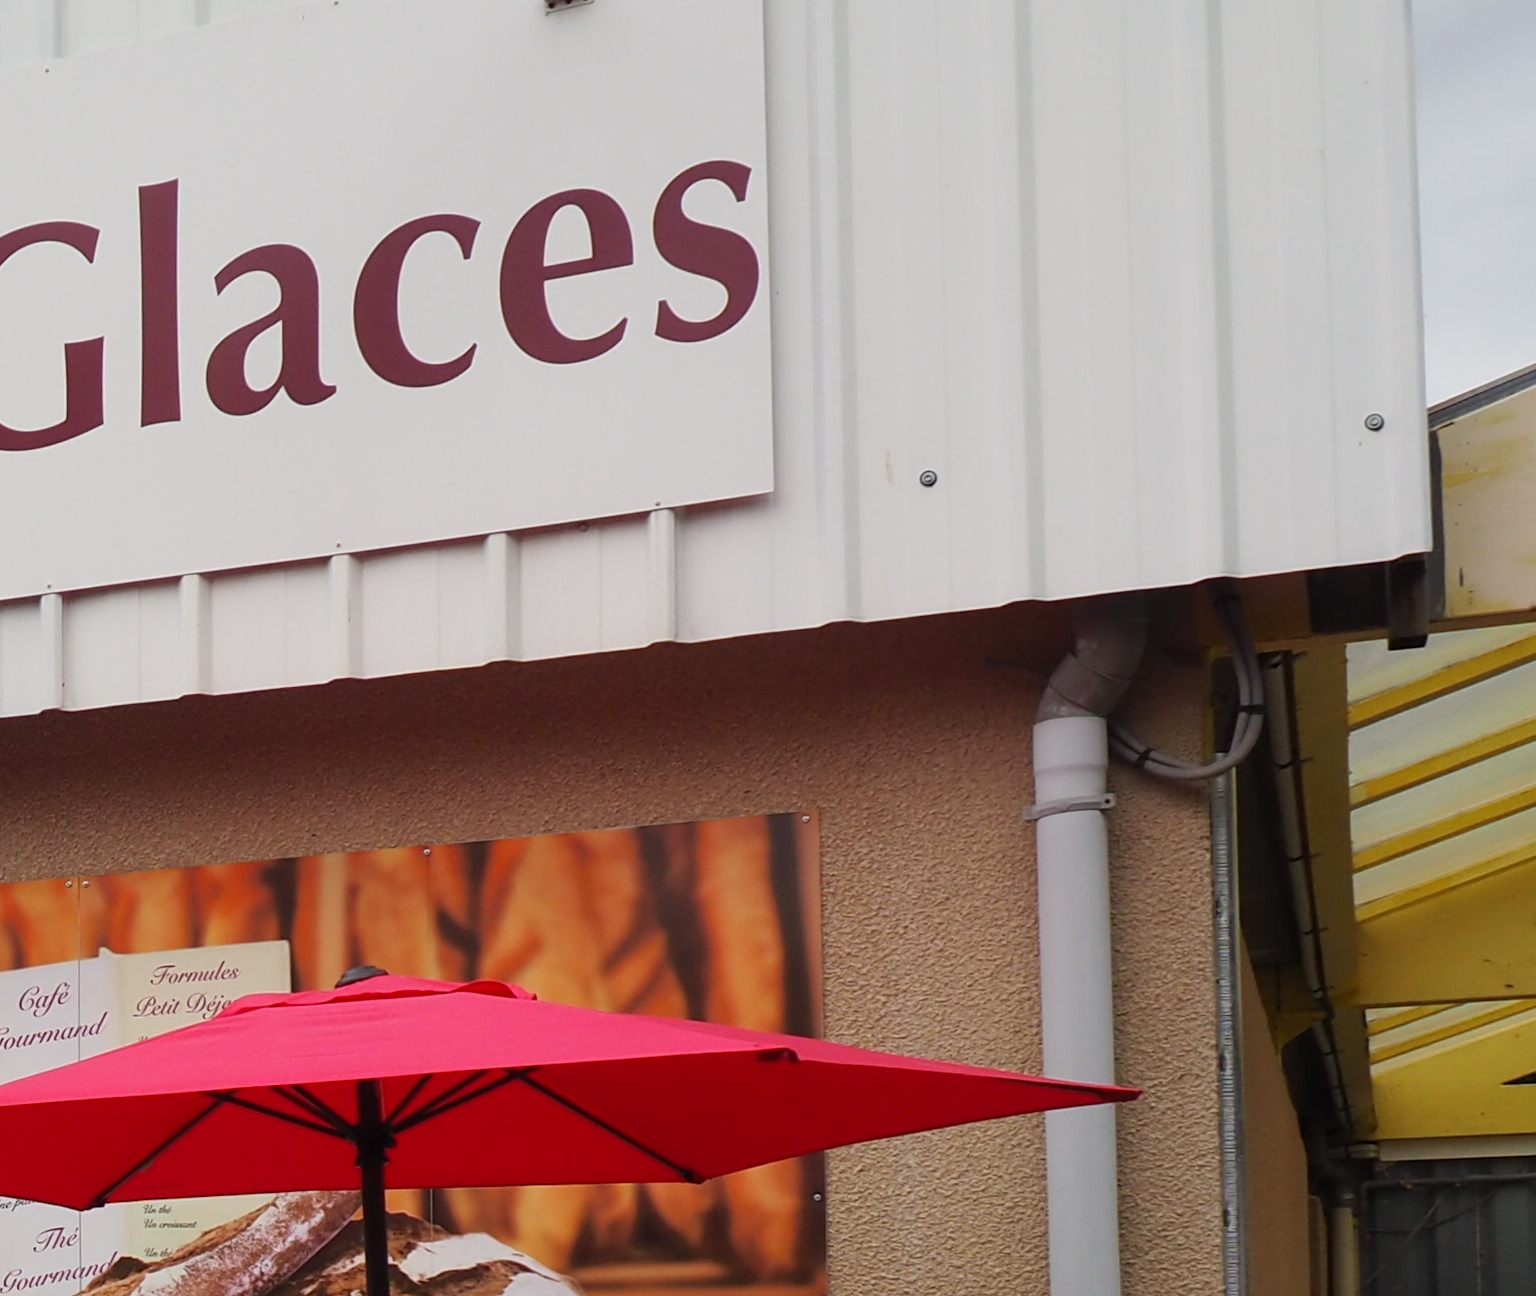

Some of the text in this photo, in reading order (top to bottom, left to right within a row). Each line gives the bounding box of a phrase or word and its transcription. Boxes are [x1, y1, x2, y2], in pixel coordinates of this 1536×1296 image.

[150, 960, 242, 986] Formules
[18, 981, 72, 1018] Café
[132, 991, 232, 1020] Petit Déje
[32, 1225, 79, 1254] Thé
[0, 1250, 119, 1295] Gourmand
